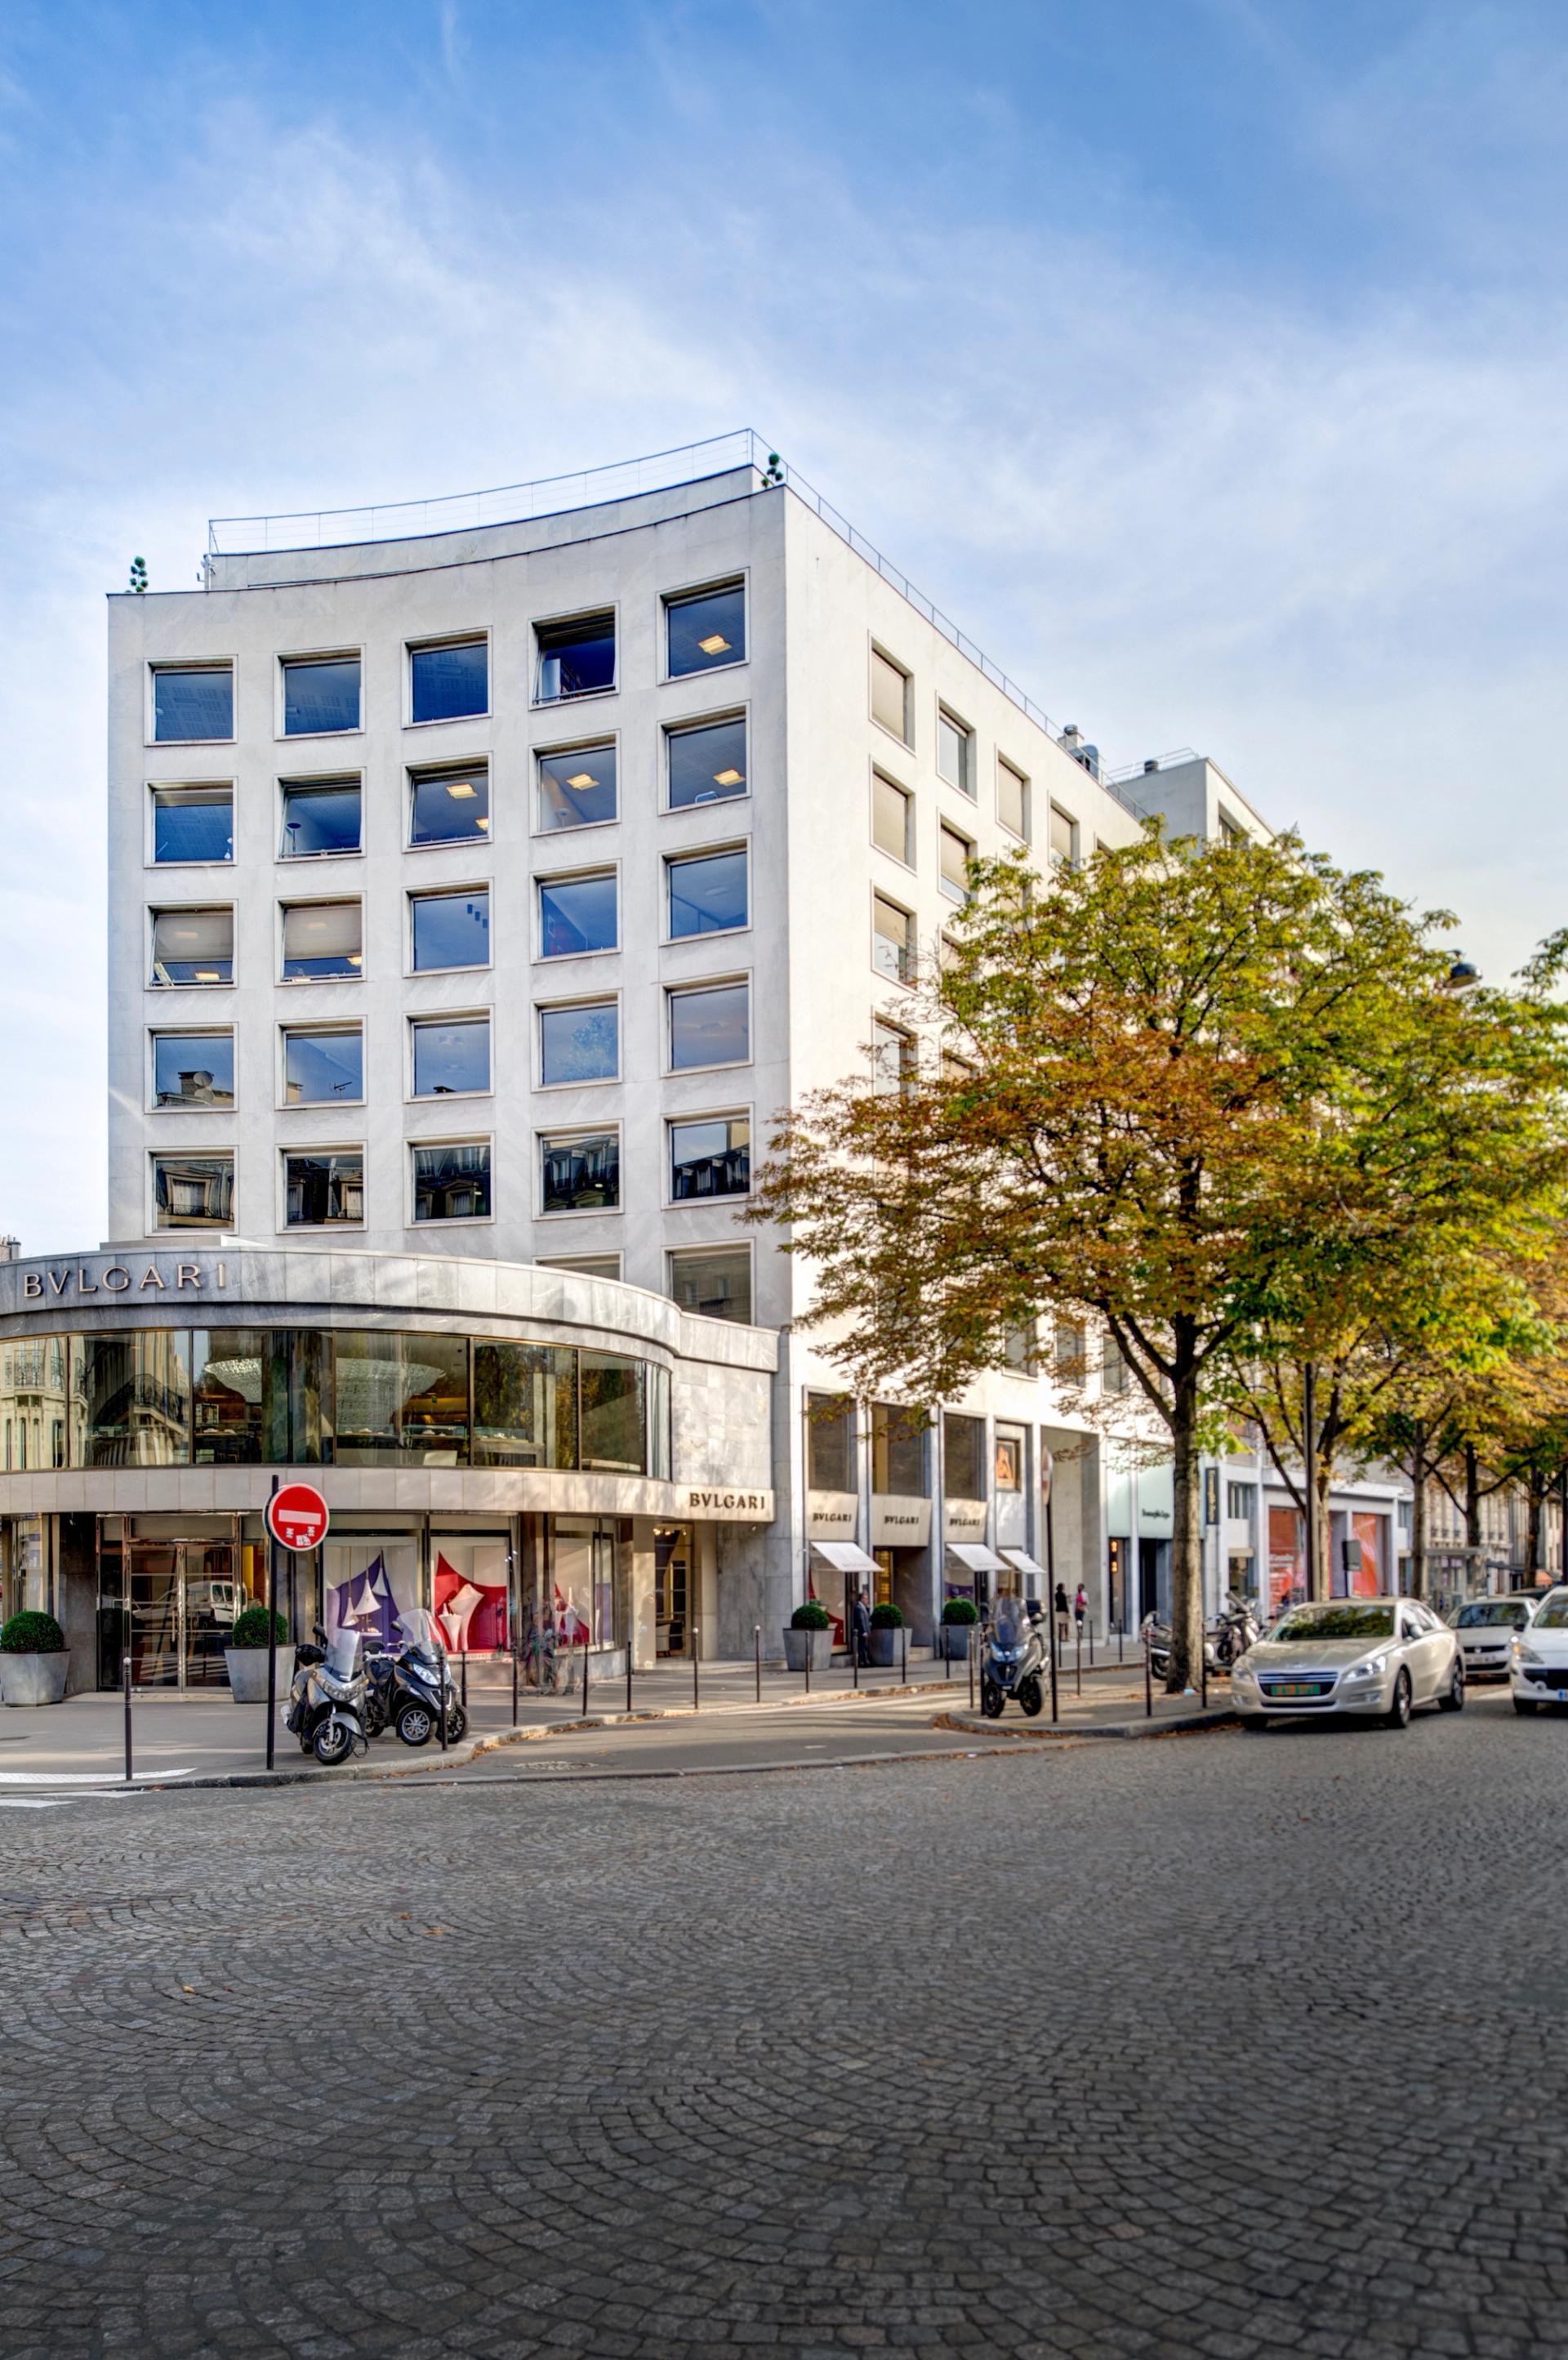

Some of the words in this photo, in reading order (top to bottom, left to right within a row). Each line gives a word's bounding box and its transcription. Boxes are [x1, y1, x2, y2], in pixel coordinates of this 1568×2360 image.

[23, 1264, 226, 1298] BVLGARI
[688, 1492, 765, 1510] BVLGARI
[813, 1513, 852, 1522] BVLGARI
